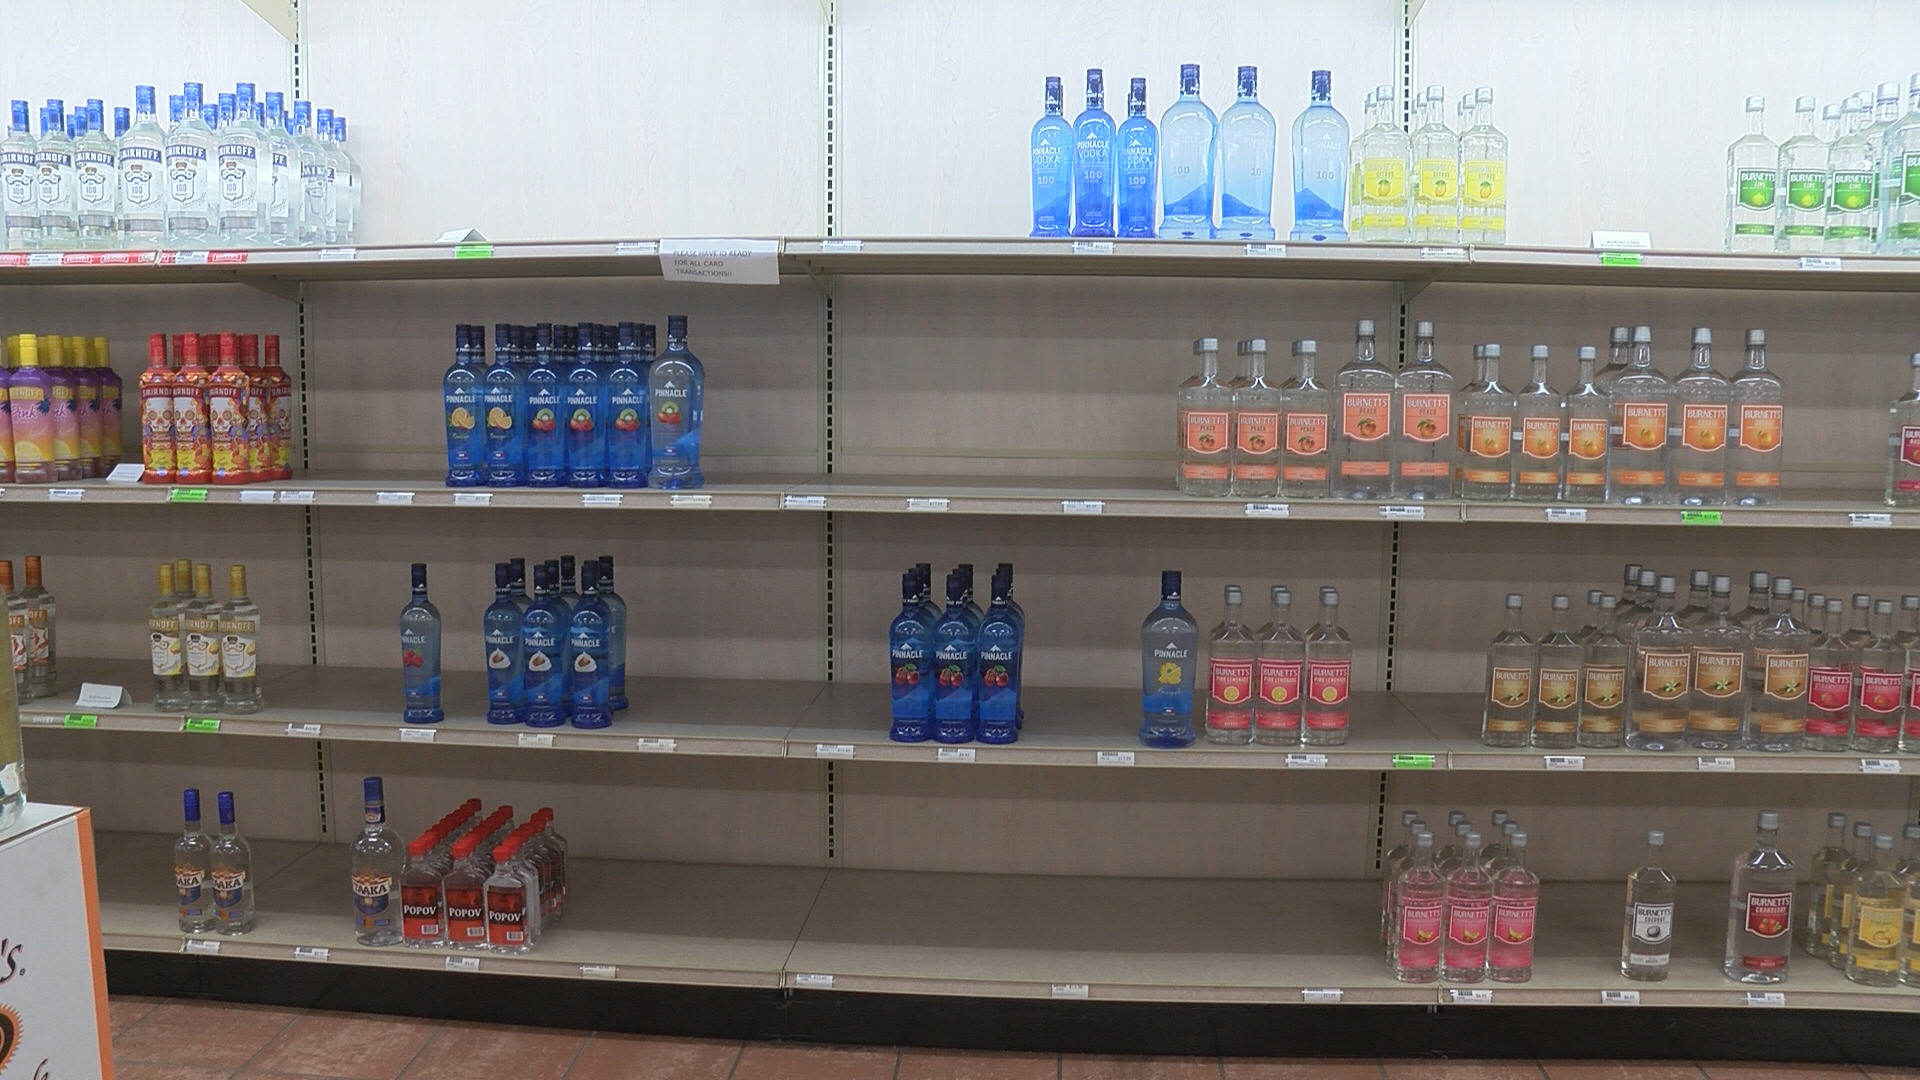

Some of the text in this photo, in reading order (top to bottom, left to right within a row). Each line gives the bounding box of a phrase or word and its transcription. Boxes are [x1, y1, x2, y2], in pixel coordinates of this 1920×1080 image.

[1076, 141, 1109, 150] PINNACLE
[1078, 150, 1108, 159] VODKA
[1084, 171, 1102, 179] 100
[1316, 171, 1334, 179] 100
[1037, 177, 1055, 185] 100
[1128, 177, 1146, 185] 100
[13, 187, 24, 195] 100
[42, 187, 52, 195] 100
[176, 184, 187, 192] 100
[227, 183, 236, 192] 100
[676, 268, 732, 277] TRANSACTIONS!!
[655, 389, 687, 397] PINNACLE
[446, 395, 476, 403] PINNACLE
[485, 394, 512, 403] PINNACLE
[529, 396, 560, 404] PINNACLE
[568, 396, 597, 404] PINNACLE
[612, 396, 643, 404] PINNACLE
[525, 637, 555, 647] PINNACLE
[571, 638, 600, 647] PINNACLE
[892, 650, 923, 659] PINNACLE
[936, 651, 967, 660] PINNACLE
[981, 651, 1012, 660] PINNACLE
[1155, 649, 1188, 658] PINNACLE
[354, 883, 387, 896] TAAKA
[404, 904, 437, 915] POPOV
[449, 908, 482, 918] POPOV
[489, 911, 521, 922] POPOV
